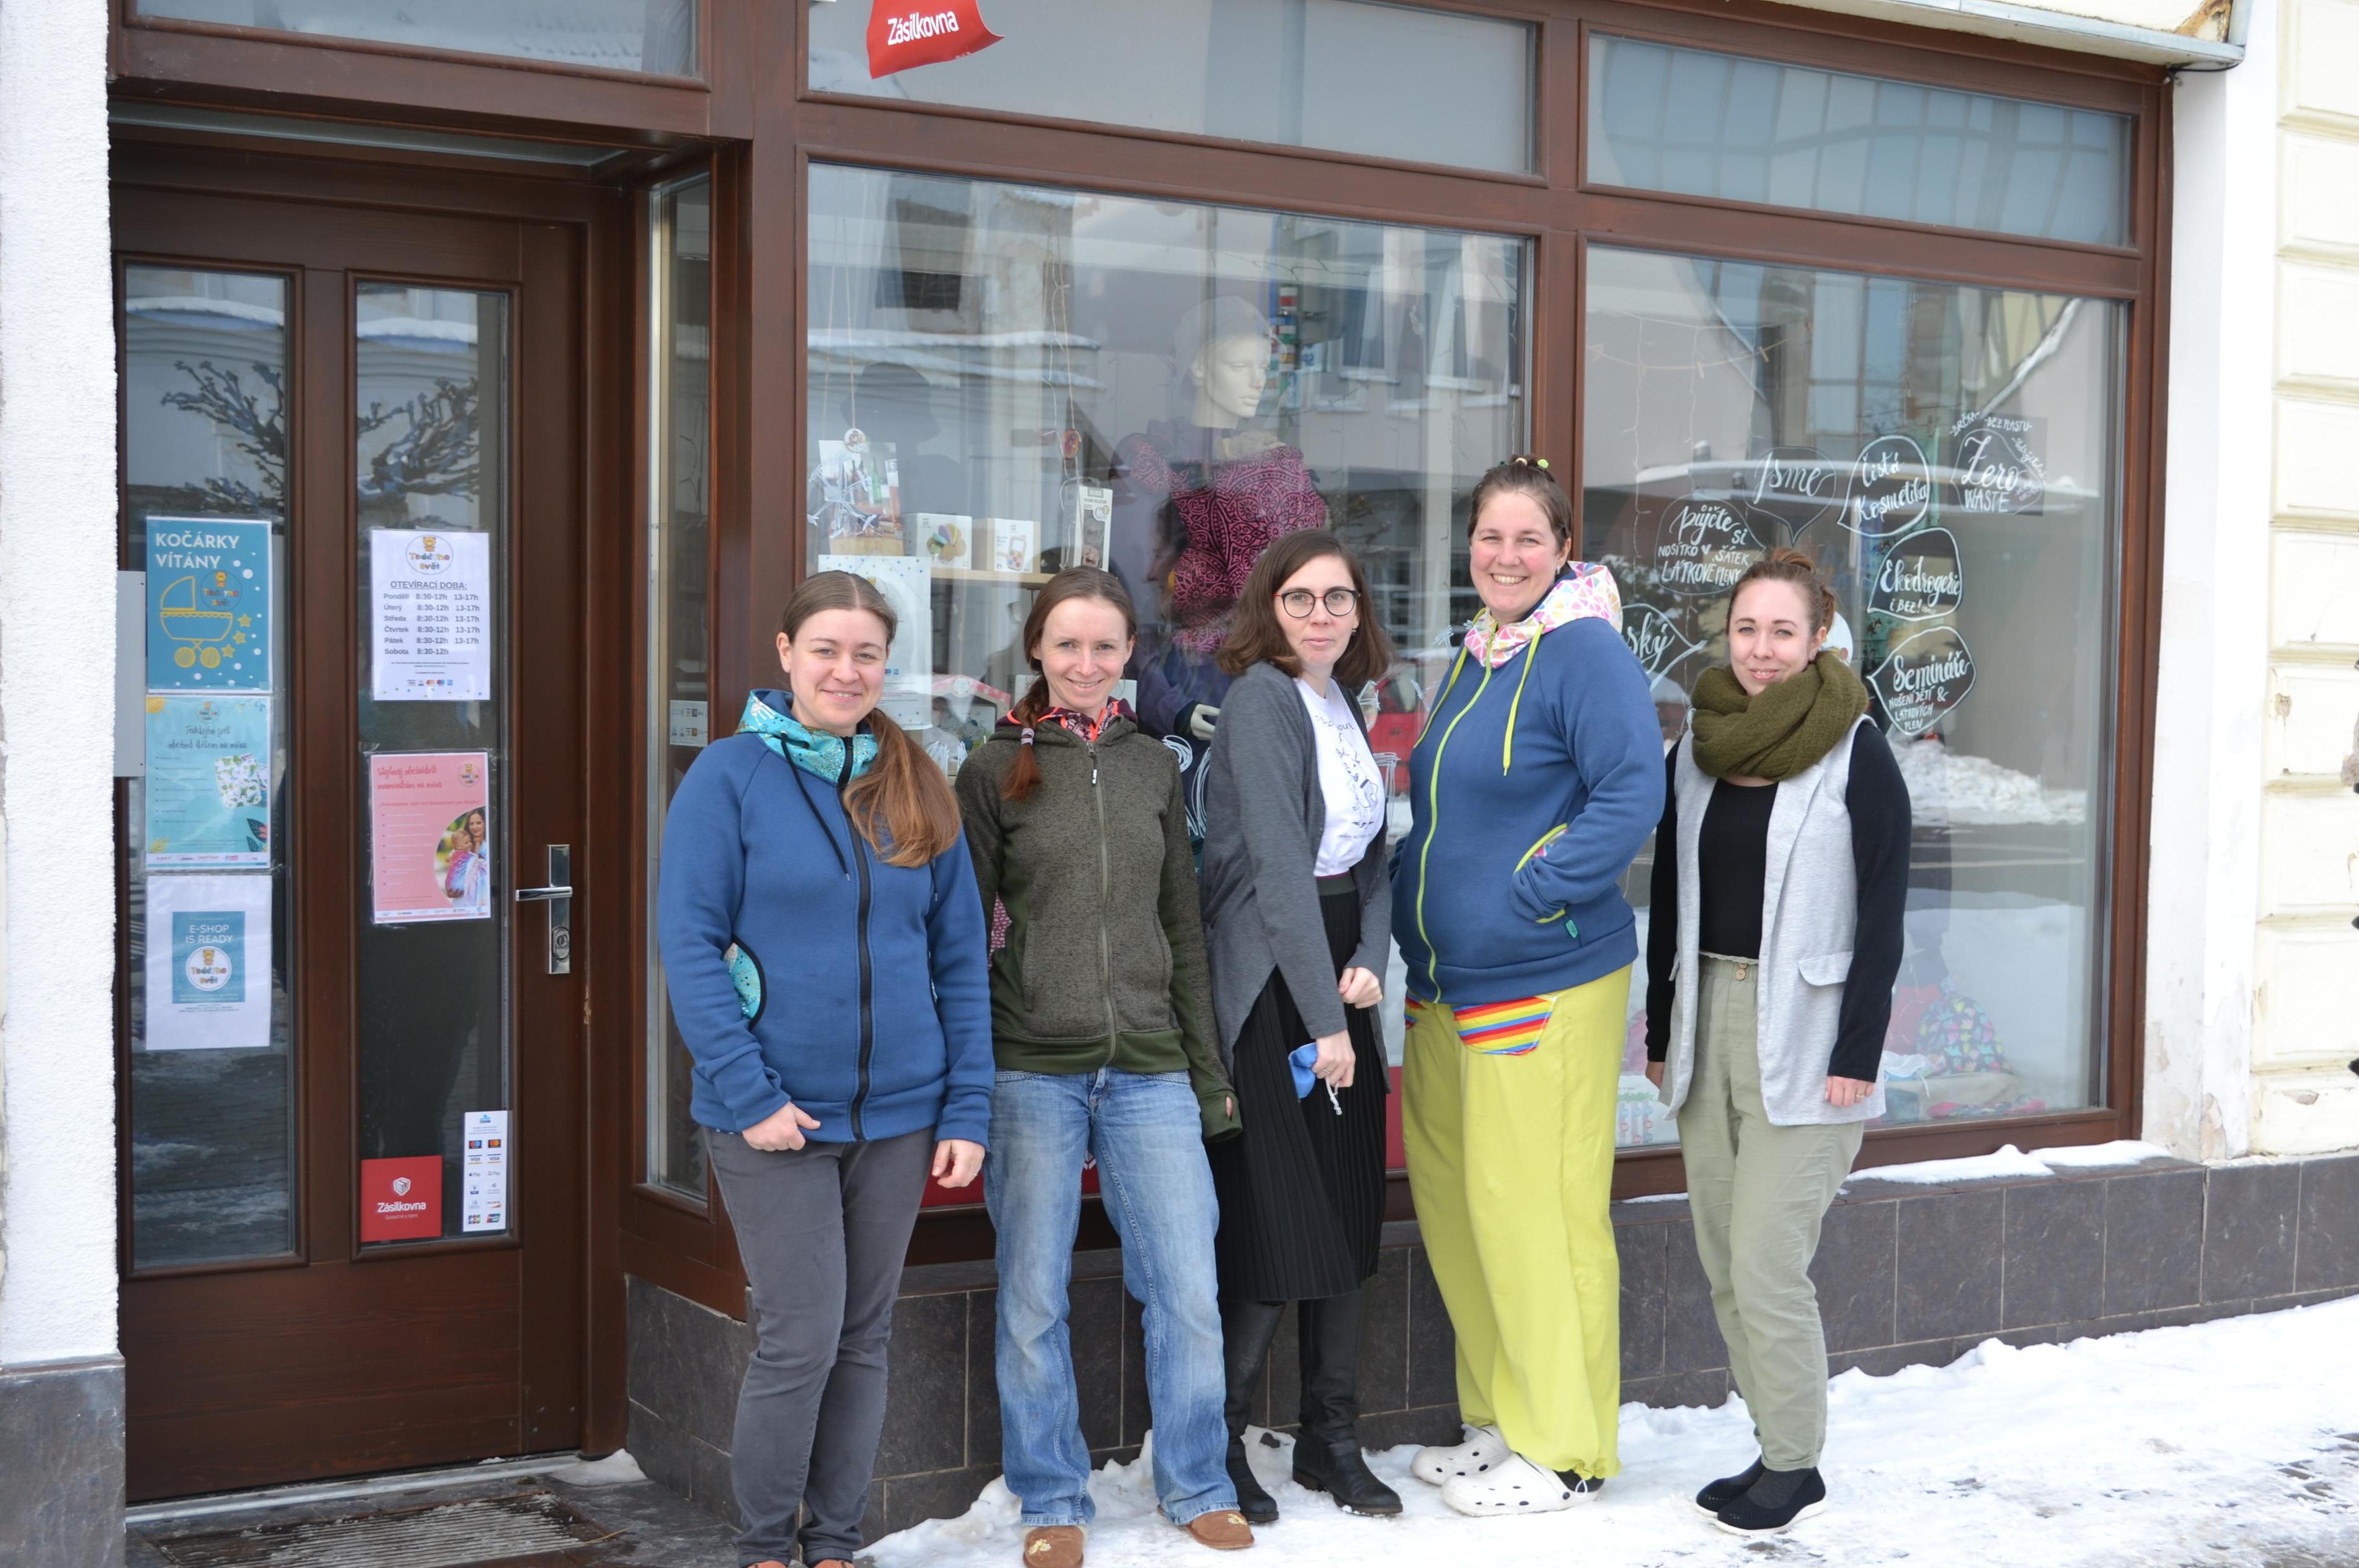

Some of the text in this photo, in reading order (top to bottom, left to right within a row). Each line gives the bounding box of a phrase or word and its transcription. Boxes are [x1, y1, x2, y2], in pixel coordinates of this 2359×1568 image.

[887, 11, 960, 45] Zásilkovna
[1961, 435, 2026, 491] Zero
[1964, 488, 2010, 513] WASTE
[155, 530, 240, 549] KOČÁRKY
[155, 551, 221, 569] VÍTÁNY
[1658, 542, 1750, 565] NOSÍTKO ŠÁTEK
[391, 581, 438, 589] OTEVÍRACÍ
[1893, 650, 1970, 692] Semináře
[1888, 685, 1949, 710] NOŠENÍ DĚTÍ &
[186, 934, 234, 944] IS READY
[190, 924, 230, 933] E-SHOP
[377, 1202, 427, 1213] Zásilkovna
